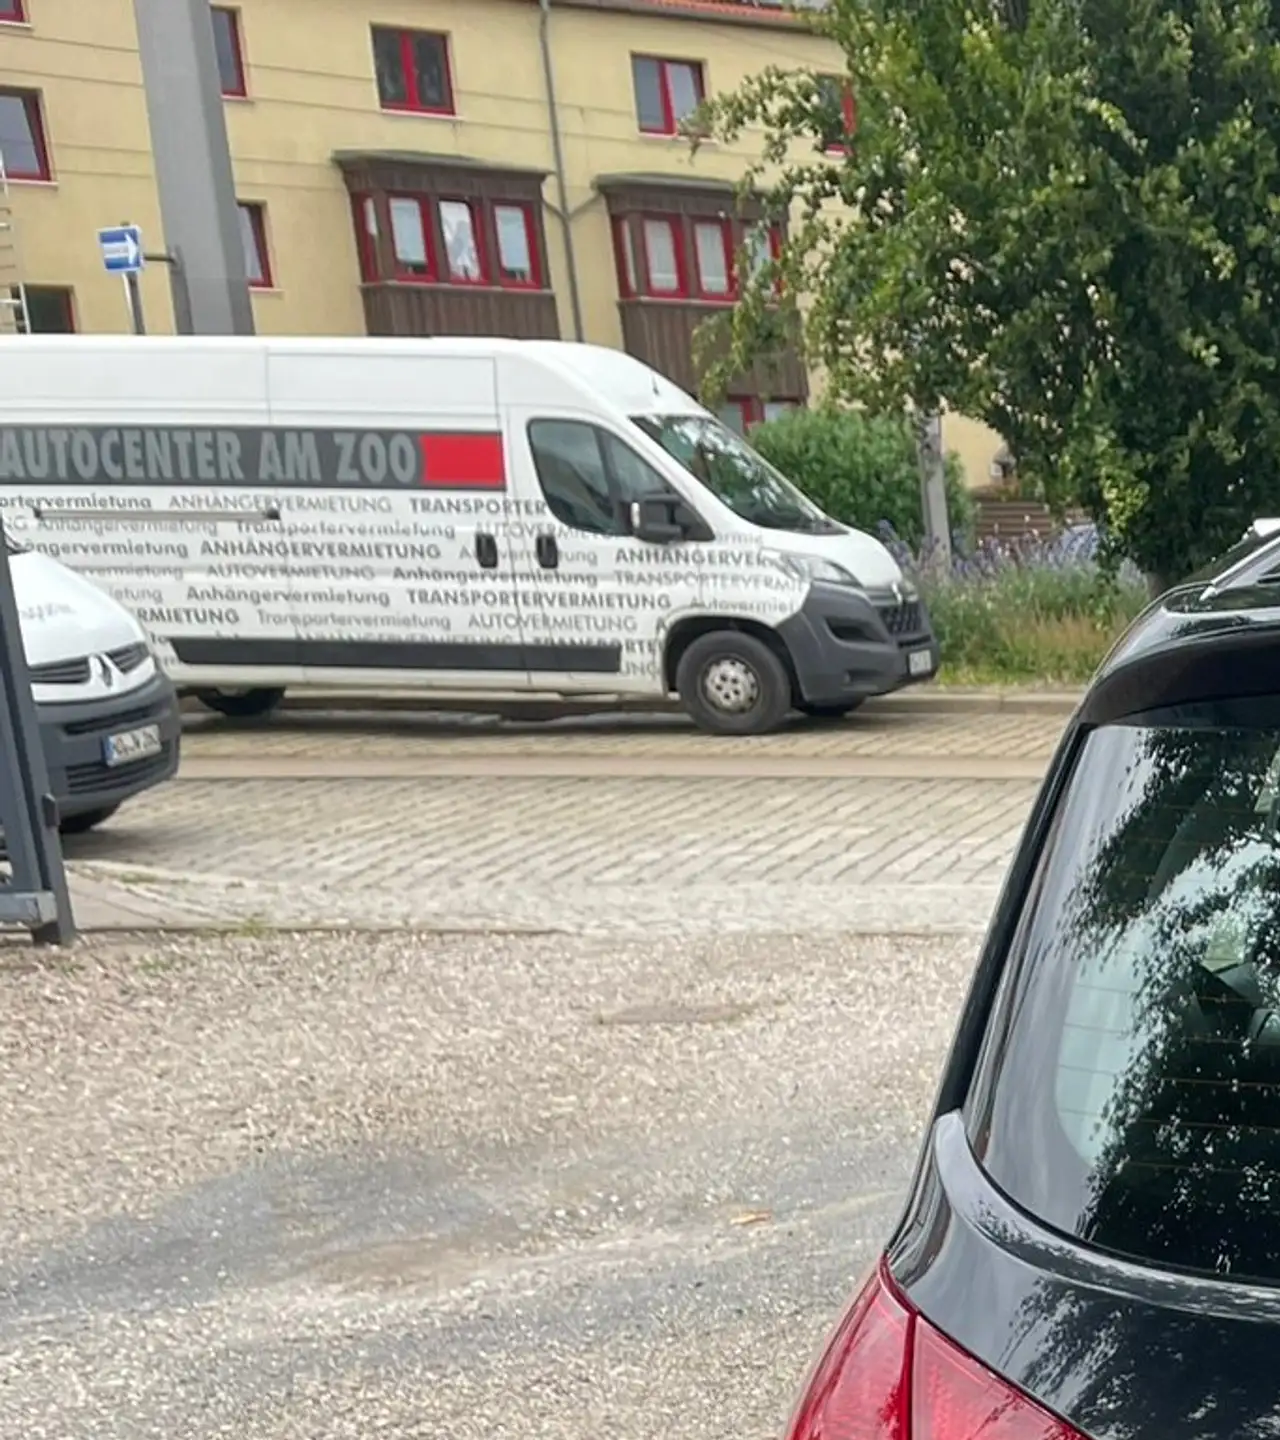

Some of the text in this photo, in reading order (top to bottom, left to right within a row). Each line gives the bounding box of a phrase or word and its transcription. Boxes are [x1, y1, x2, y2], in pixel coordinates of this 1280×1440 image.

[0, 428, 417, 483] AUTOCENTER AM ZOO
[200, 538, 441, 560] ANHÄNGERVERMIETUNG
[406, 588, 672, 610] TRANSPORTERVERMIETUNG
[468, 613, 638, 633] AUTOVERMIETUNG
